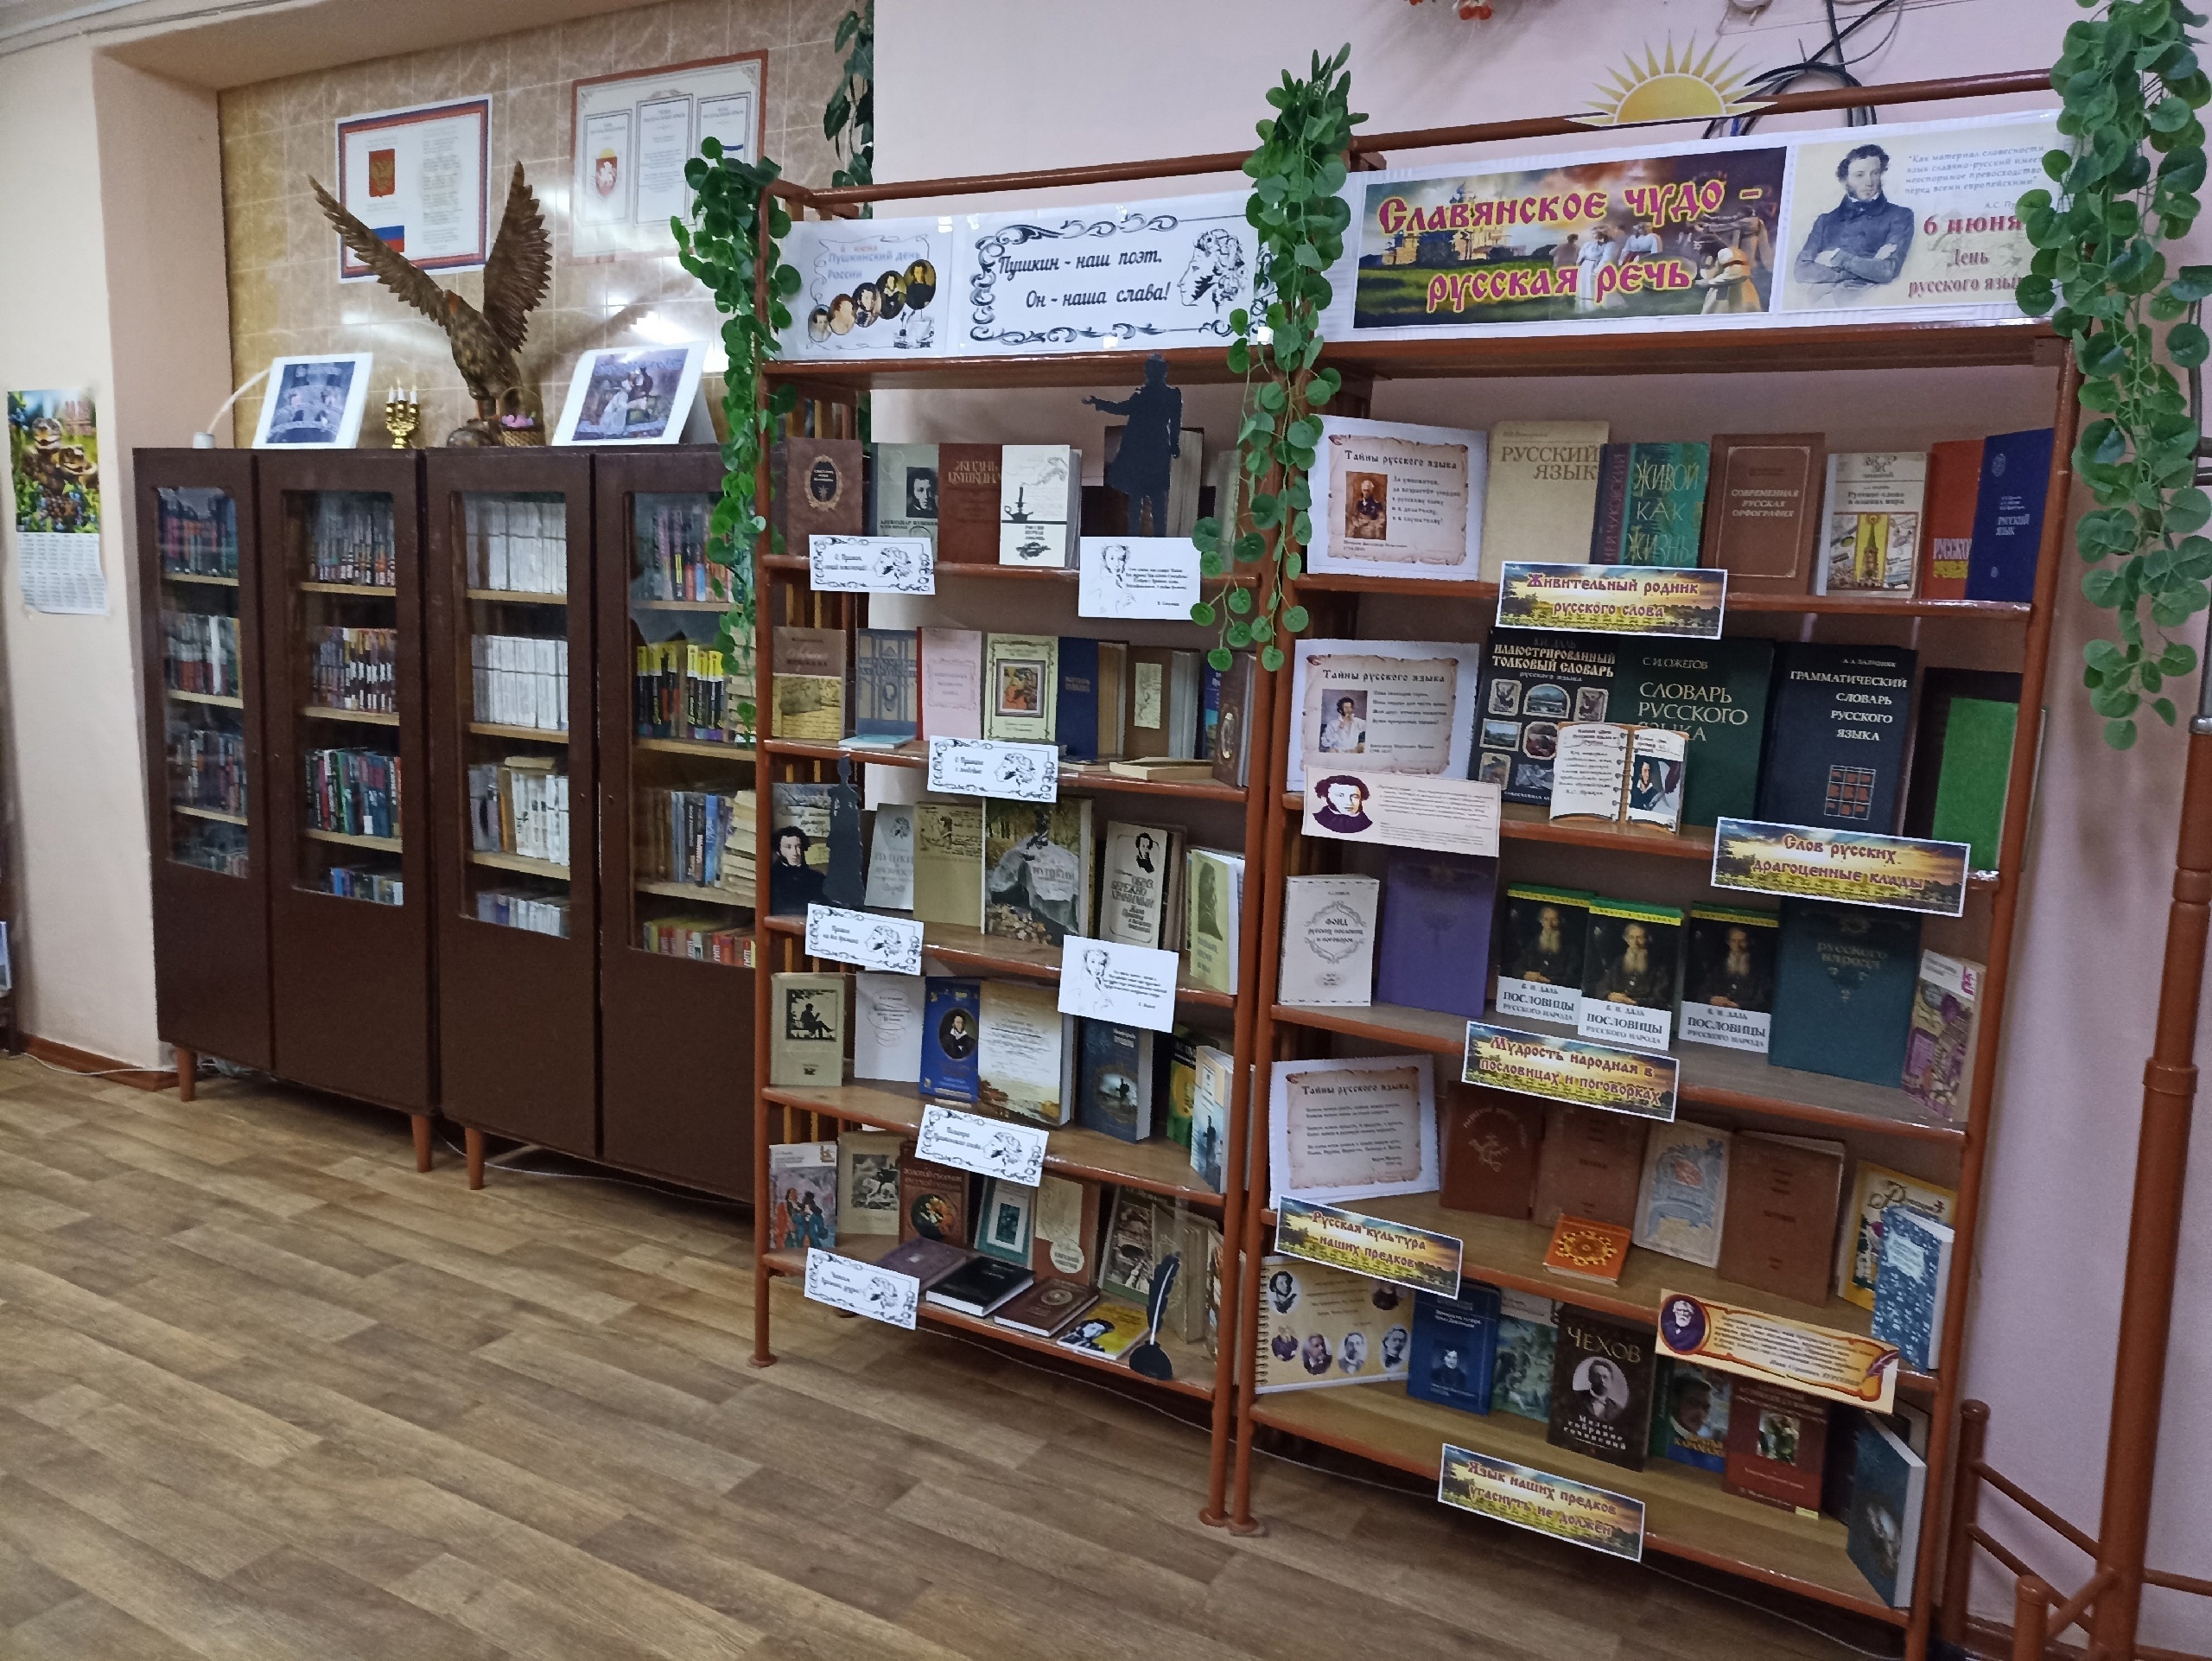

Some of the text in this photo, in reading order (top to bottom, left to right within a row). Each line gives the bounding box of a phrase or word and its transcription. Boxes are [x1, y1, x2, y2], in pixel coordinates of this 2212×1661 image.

[1378, 191, 1608, 233] Славянское
[1624, 179, 1725, 227] чудо
[1923, 214, 1938, 235] 6
[998, 256, 1059, 281] Пушкин
[1075, 254, 1110, 269] наш
[1117, 250, 1163, 265] поэт.
[1947, 247, 1990, 268] День
[1026, 290, 1046, 308] Он
[1062, 291, 1107, 307] наша
[1116, 282, 1172, 302] слава!
[1426, 259, 1694, 314] русская речь
[1908, 277, 1980, 298] русского
[1344, 449, 1458, 471] Тайны русского языка
[1501, 444, 1597, 463] РУССКИЙ
[1533, 464, 1597, 481] ЯЗЫК
[1633, 460, 1700, 497] ЖИВОЙ
[1731, 488, 1799, 499] СОВРЕМЕННАЯ
[1741, 499, 1787, 508] РУССКАЯ
[1637, 501, 1687, 521] КАК
[1526, 572, 1699, 596] Живительный родник
[1553, 601, 1664, 618] русского слова
[1493, 644, 1616, 665] ИЛЛЮСТРИРОВАННЫЙ
[1322, 669, 1359, 681] Тайны
[1363, 672, 1408, 683] русского
[1492, 655, 1614, 678] ТОЛКОВЫЙ СЛОВАРЬ
[1789, 671, 1907, 689] ГРАММАТИЧЕСКИЙ
[1639, 681, 1732, 704] СЛОВАРЬ
[1835, 692, 1892, 706] СЛОВАРЬ
[1638, 701, 1749, 726] РУССКОГО
[1830, 709, 1893, 724] РУССКОГО
[1836, 729, 1880, 741] ЯЗЫКА
[1783, 833, 1897, 864] Слов русских
[1751, 859, 1923, 890] драгоценные клады
[1503, 991, 1574, 1012] ПОСЛОВИЦЫ
[1586, 1012, 1662, 1035] ПОСЛОВИЦЫ
[1687, 1016, 1766, 1038] ПОСЛОВИЦЫ
[1490, 1036, 1564, 1061] Мудрость
[1570, 1052, 1639, 1075] народная
[1301, 1085, 1335, 1095] Тайны
[1479, 1059, 1560, 1086] пословицах
[1580, 1078, 1662, 1105] поговорках
[1312, 1210, 1426, 1251] Русская культура
[1319, 1236, 1414, 1268] наших предков
[1567, 1326, 1641, 1364] ЧЕХОВ
[1467, 1461, 1618, 1516] Язык наших предков
[1536, 1505, 1554, 1518] не
[1558, 1511, 1613, 1537] должен
